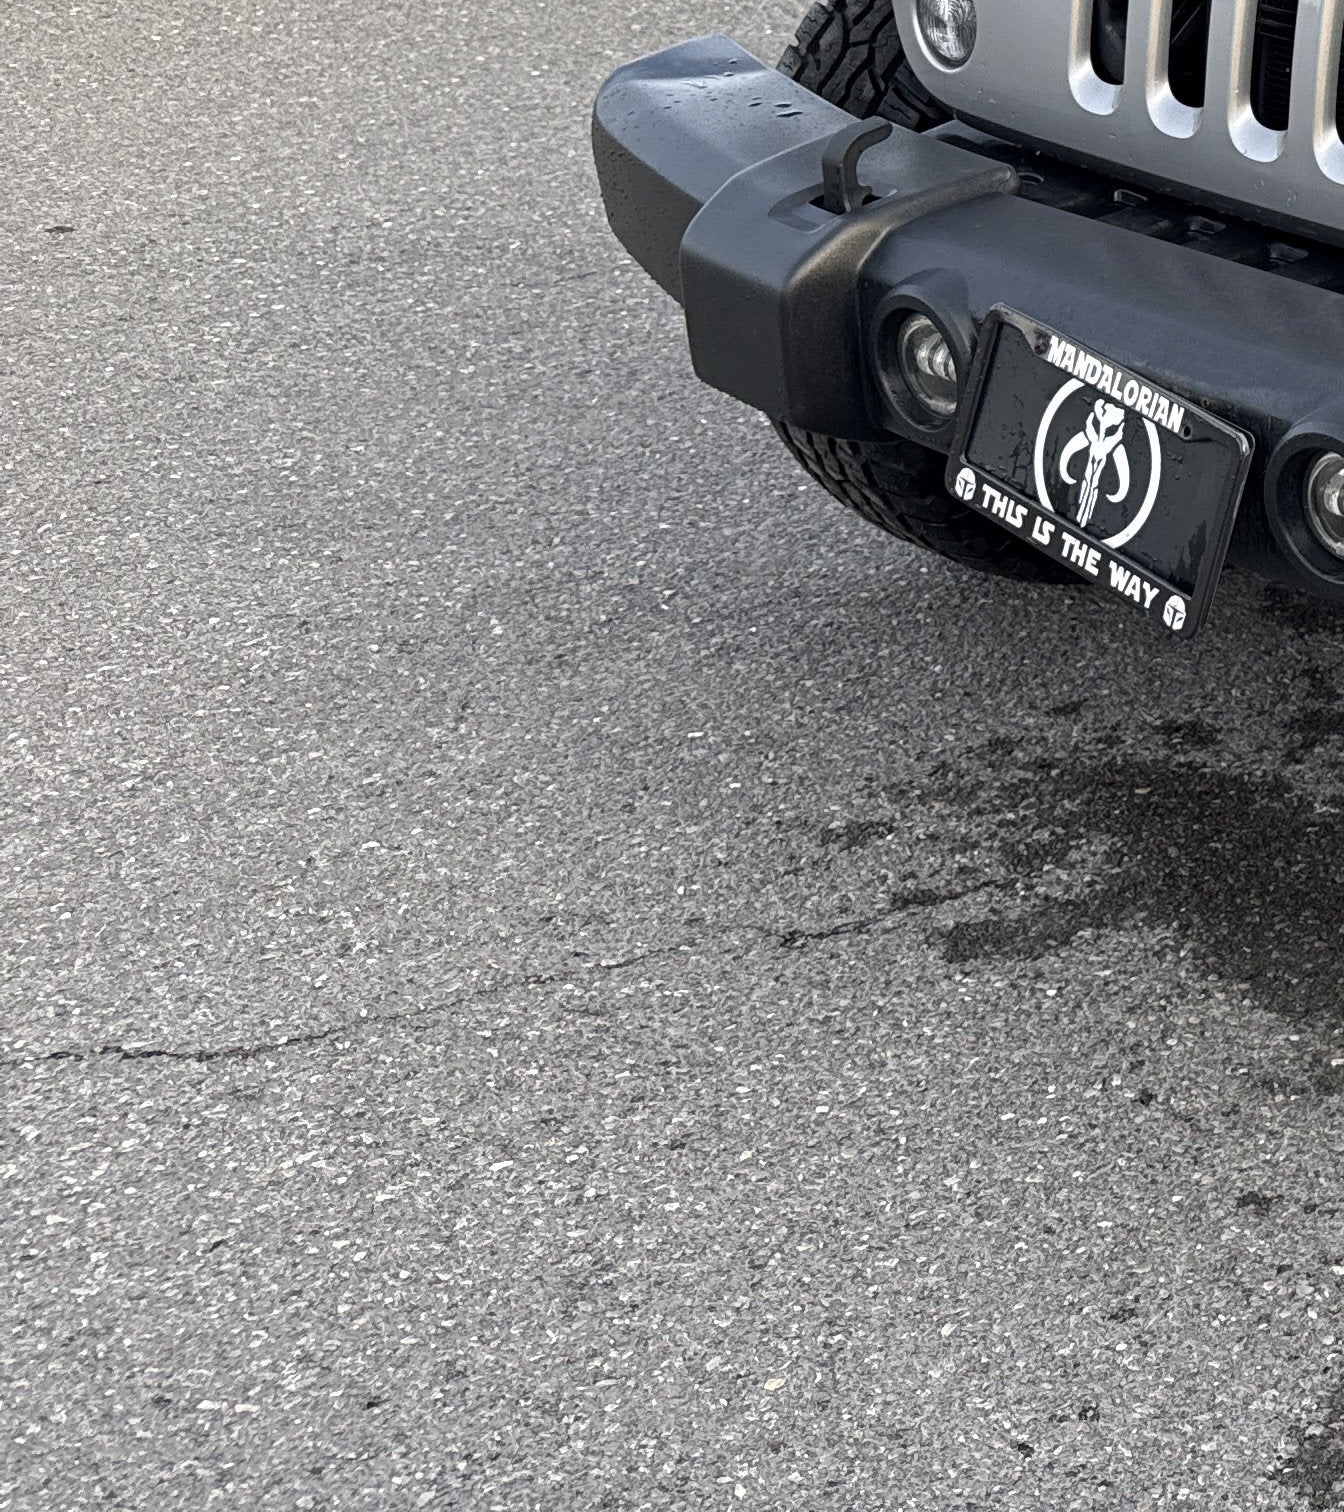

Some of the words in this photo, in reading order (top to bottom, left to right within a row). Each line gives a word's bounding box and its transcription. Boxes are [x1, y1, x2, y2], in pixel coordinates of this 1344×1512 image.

[1046, 334, 1185, 434] MANDALORIAN
[982, 483, 1029, 529] THIS
[1031, 515, 1056, 546] IS
[1060, 531, 1102, 577] THE
[1108, 559, 1160, 609] WAY
